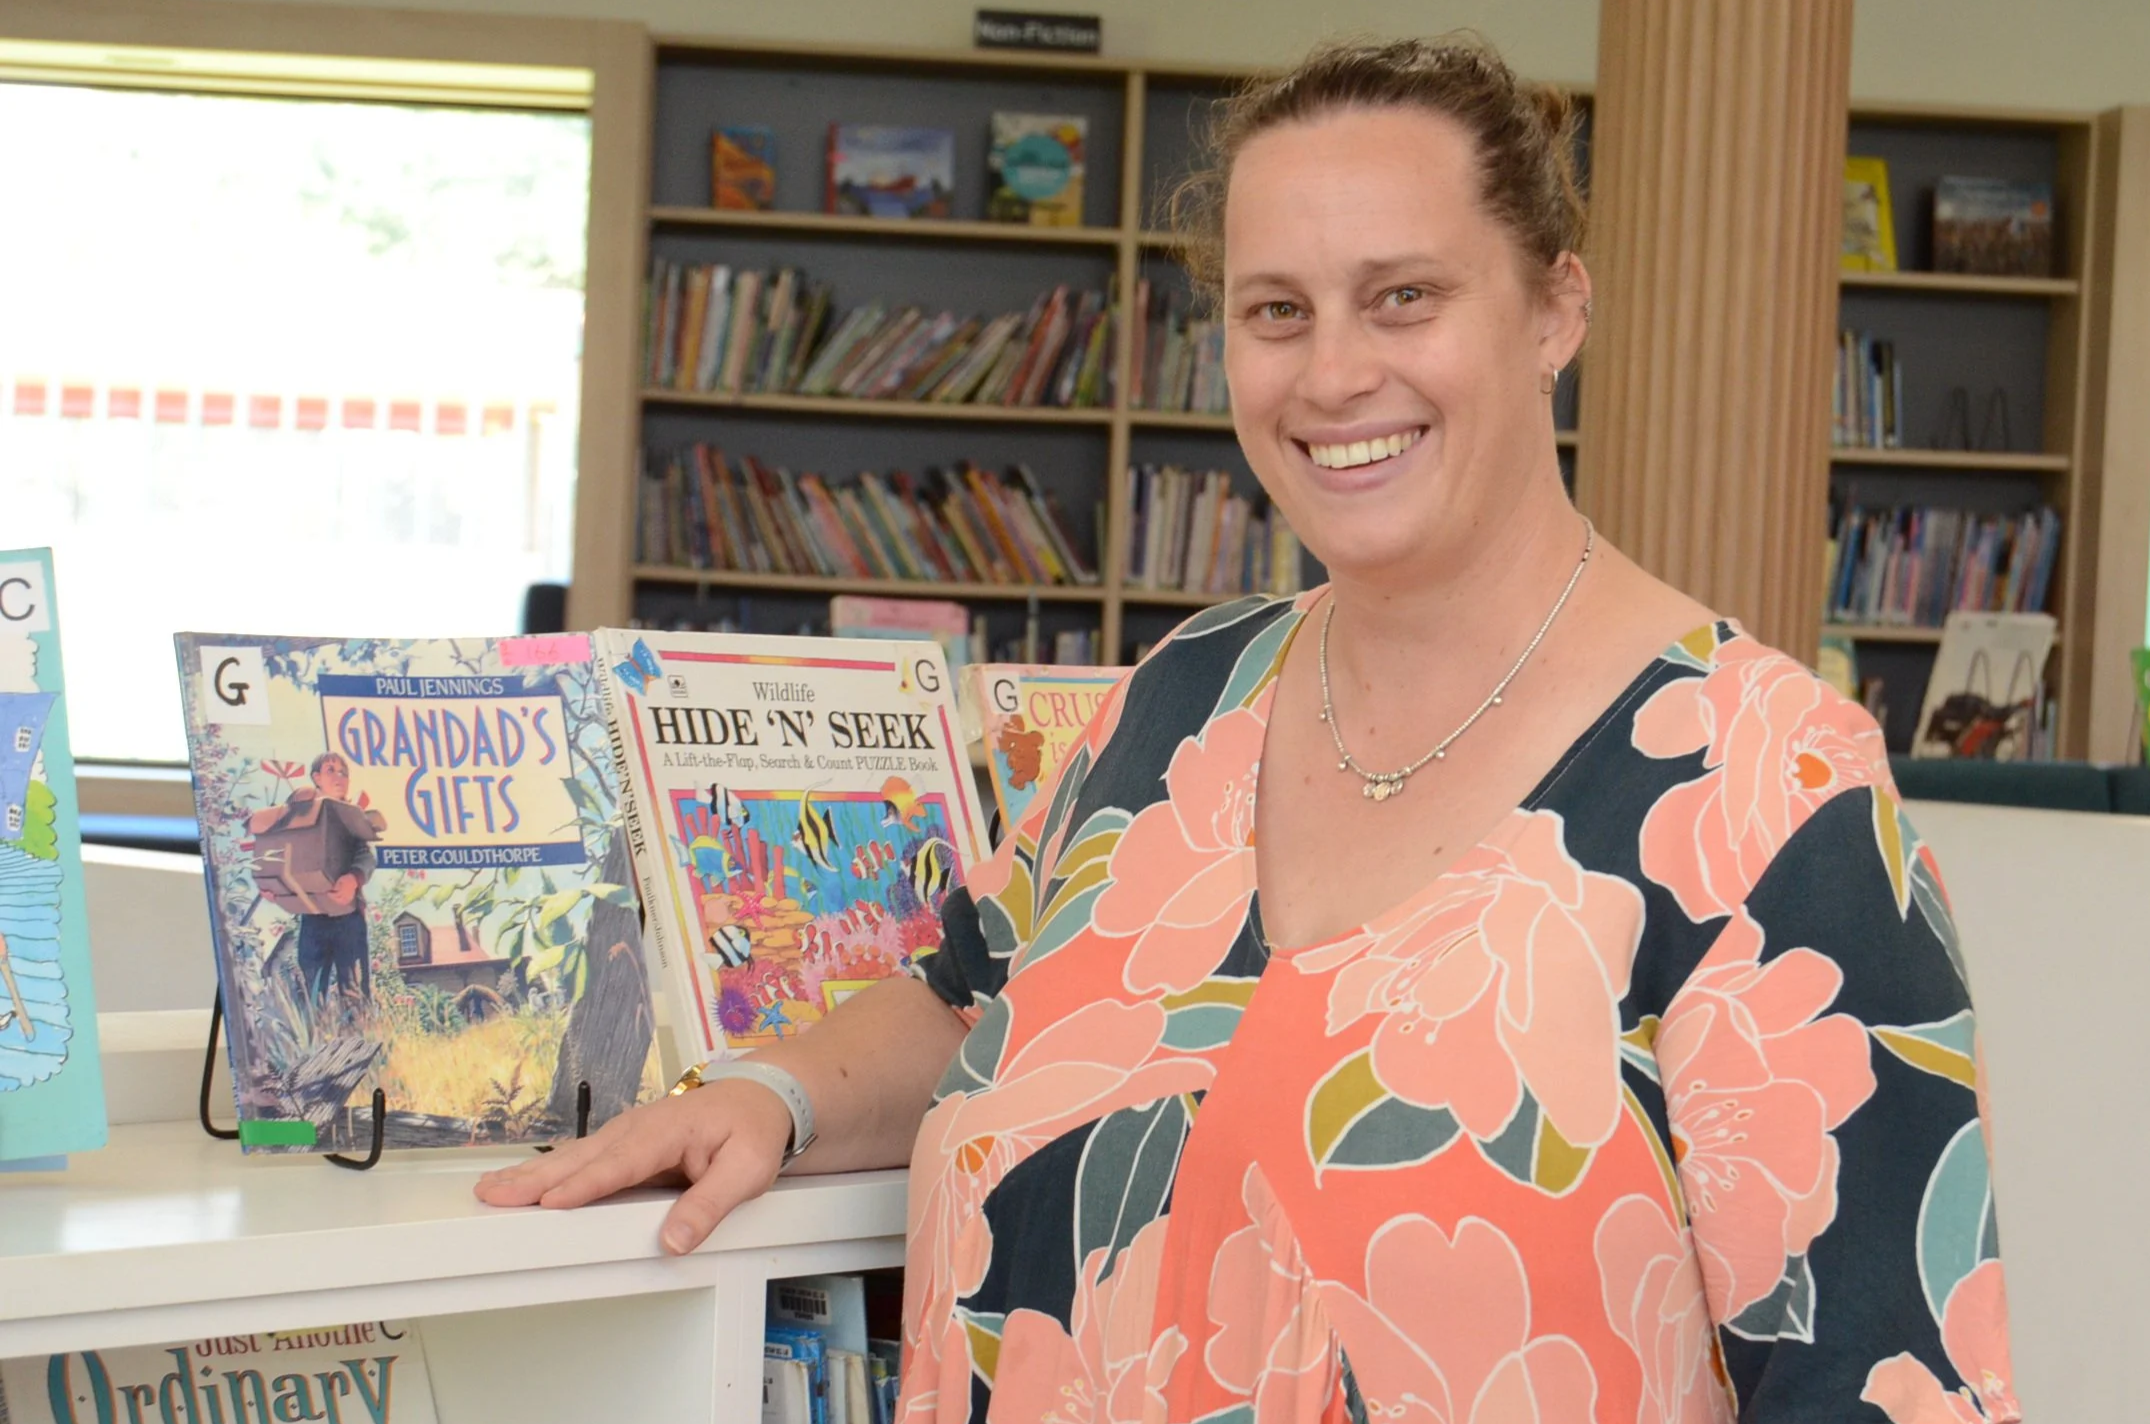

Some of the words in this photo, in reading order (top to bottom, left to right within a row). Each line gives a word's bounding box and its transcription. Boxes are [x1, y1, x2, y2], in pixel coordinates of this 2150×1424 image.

[977, 19, 1099, 47] Non-Fiction
[0, 577, 36, 621] C
[214, 656, 250, 707] G
[376, 678, 418, 696] PAUL
[419, 677, 505, 698] JENNINGS
[752, 682, 815, 703] Wildlife
[914, 658, 941, 693] G
[993, 678, 1020, 713] G
[338, 705, 556, 769] GRANDAD'S
[648, 706, 759, 746] HIDE
[827, 710, 936, 750] SEEK
[663, 753, 674, 767] A
[675, 753, 758, 771] Lift-the-Flap,
[760, 754, 801, 769] Search
[803, 756, 814, 769] &
[816, 756, 853, 770] Count
[855, 756, 905, 771] PUZZLE
[909, 757, 938, 772] Book
[404, 769, 520, 838] GIFTS
[383, 849, 427, 865] PETER
[430, 847, 542, 865] GOULDTHORPE
[46, 1347, 399, 1424] Ordinary
